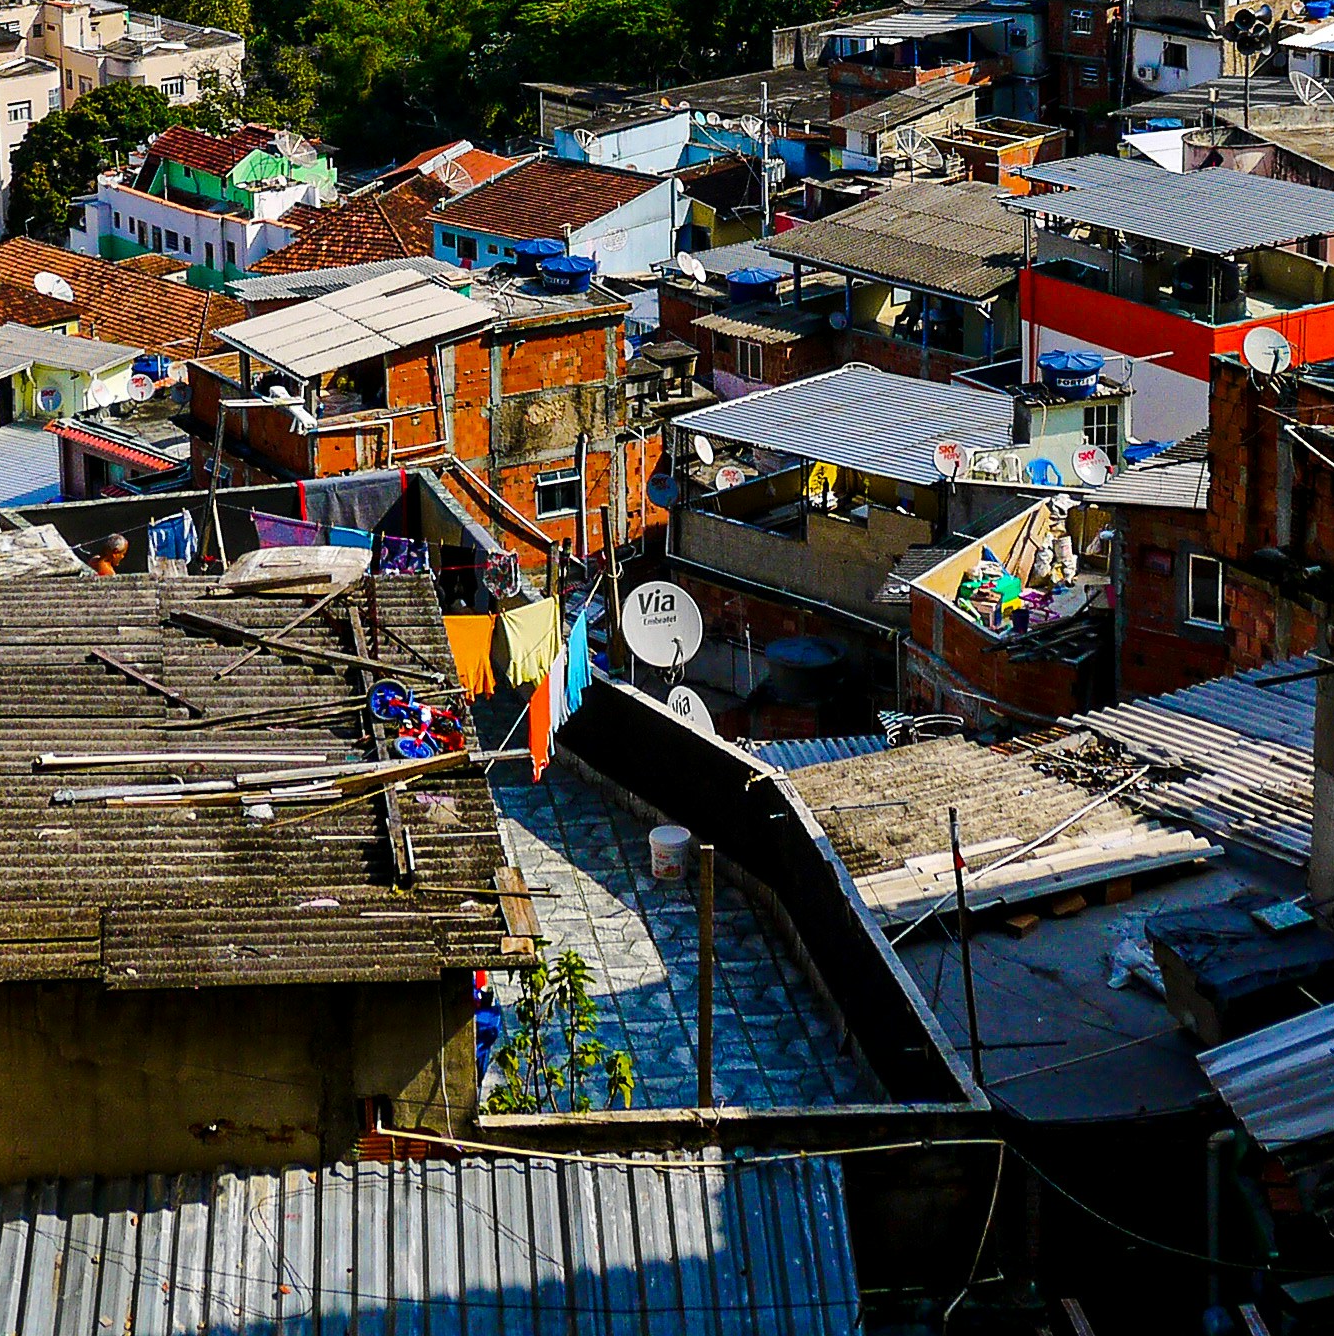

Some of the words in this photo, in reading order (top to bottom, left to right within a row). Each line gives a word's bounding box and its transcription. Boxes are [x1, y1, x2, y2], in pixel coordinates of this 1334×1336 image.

[938, 444, 957, 454] SKY
[1078, 449, 1096, 461] SKY
[638, 589, 674, 614] Via
